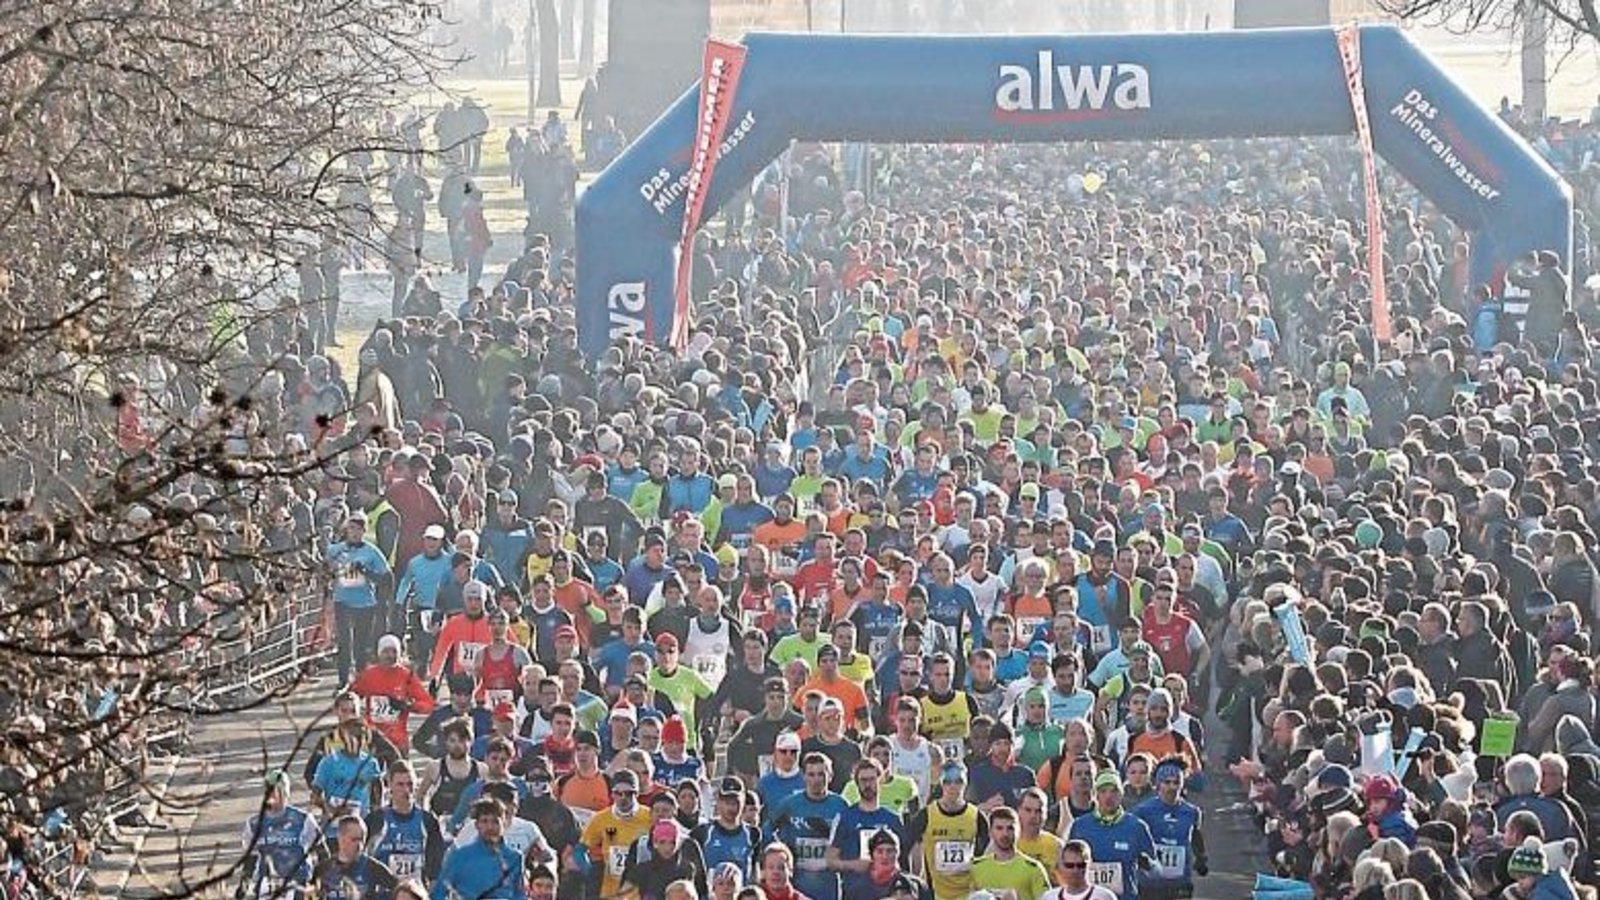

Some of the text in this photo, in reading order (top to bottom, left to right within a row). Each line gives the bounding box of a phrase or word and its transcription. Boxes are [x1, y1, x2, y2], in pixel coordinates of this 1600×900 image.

[996, 50, 1151, 111] alwa
[1404, 89, 1439, 120] Das
[1390, 103, 1501, 200] Mineralwasser
[640, 167, 671, 201] Das
[944, 849, 964, 863] 123
[1094, 870, 1114, 885] 107
